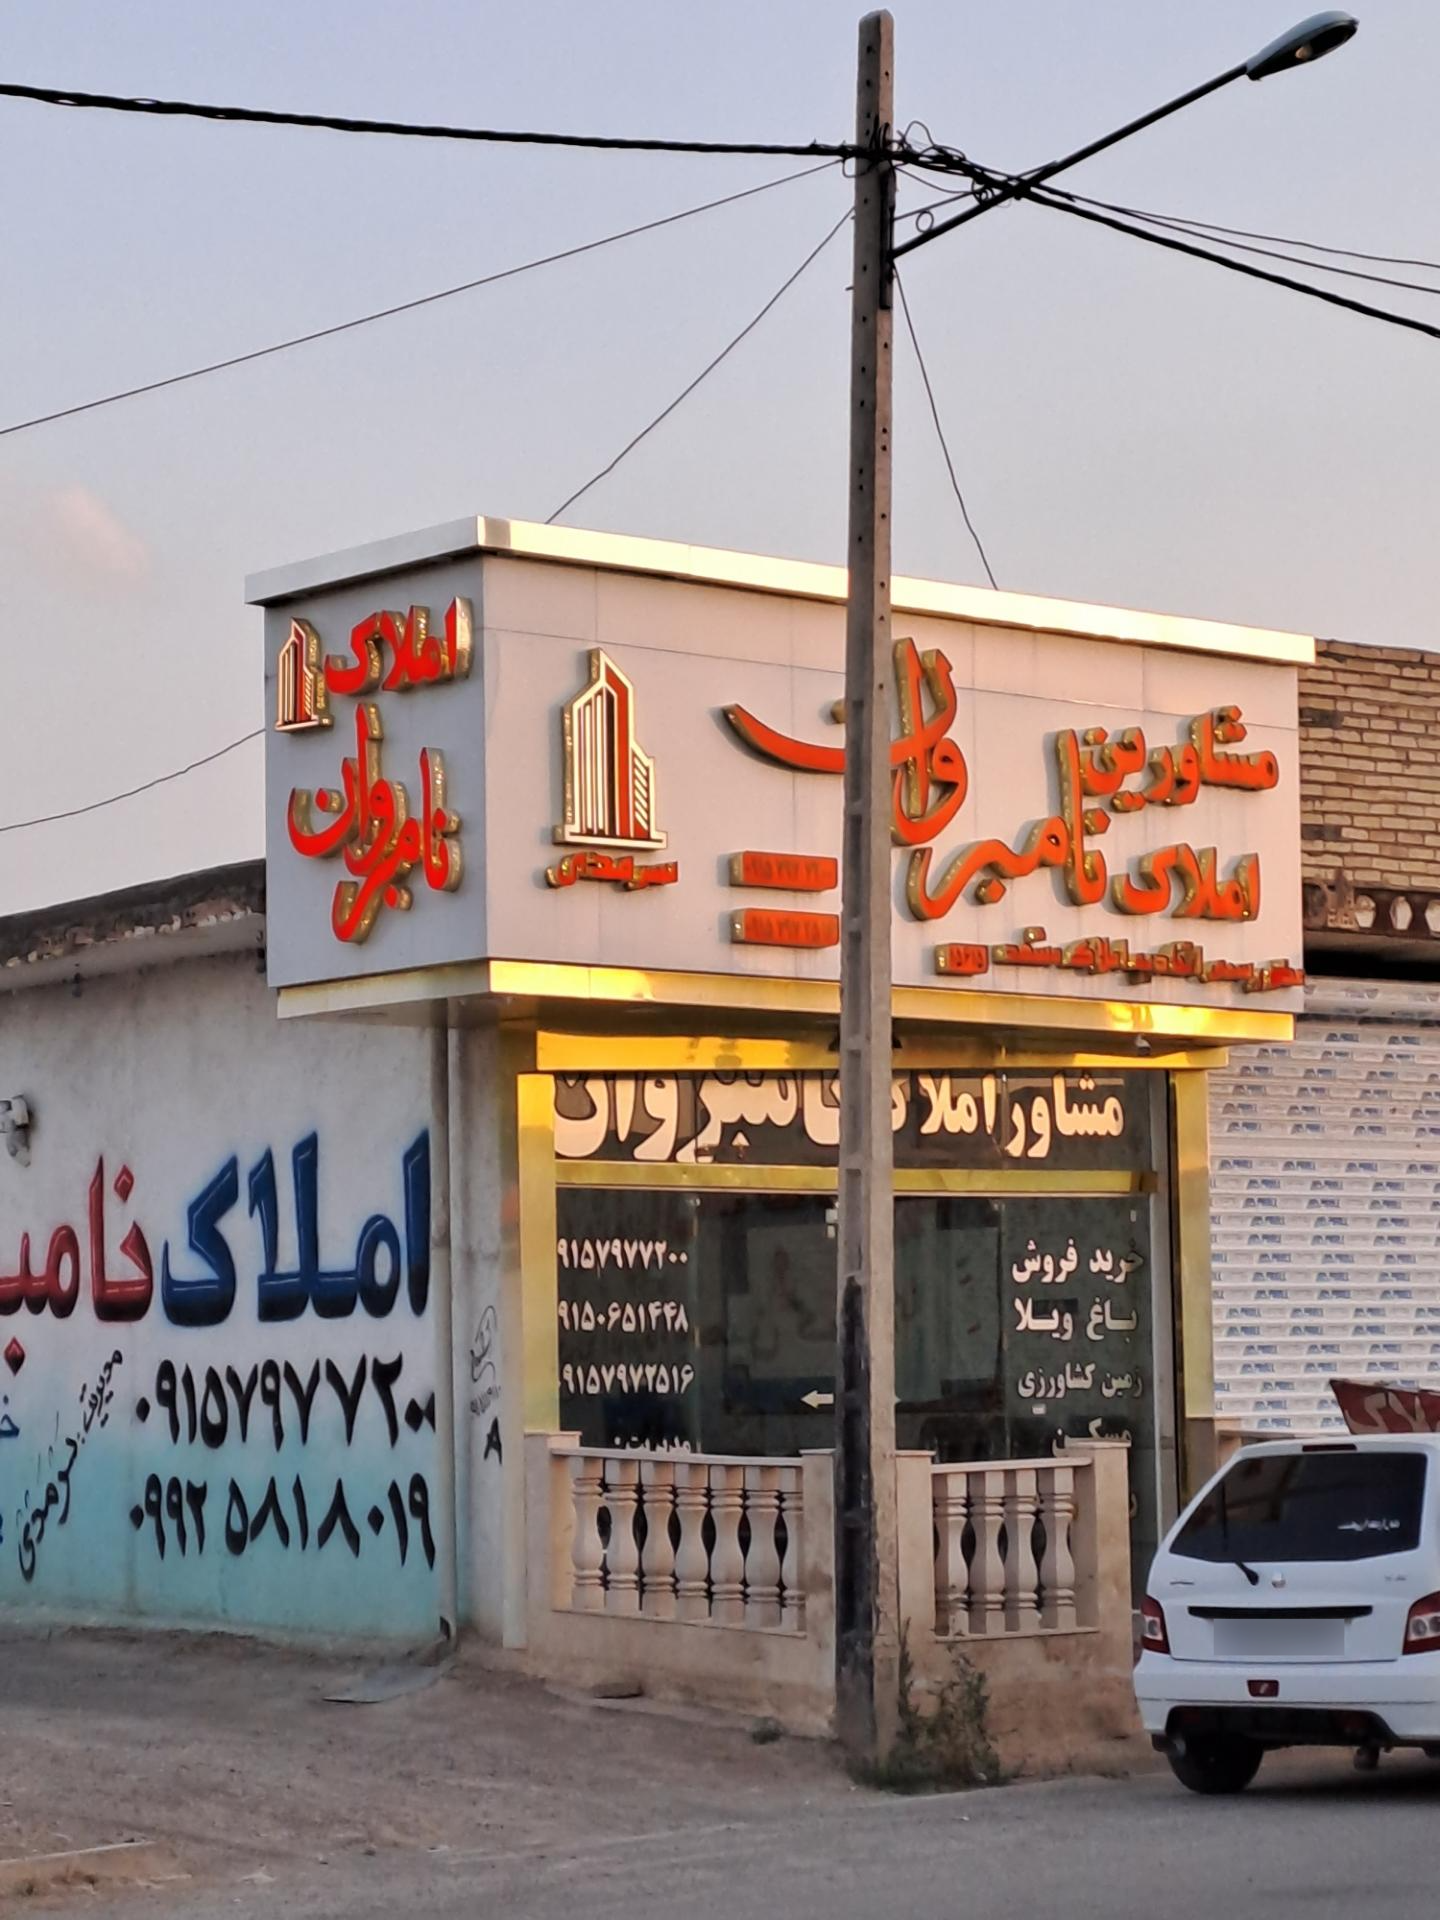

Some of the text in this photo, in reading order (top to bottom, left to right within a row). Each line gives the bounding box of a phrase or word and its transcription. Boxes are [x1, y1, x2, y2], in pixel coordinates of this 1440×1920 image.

[324, 596, 471, 694] املاک
[1080, 705, 1279, 804] مشاورین
[1112, 842, 1260, 921] املاک
[1006, 1072, 1124, 1158] مشاور
[160, 1127, 431, 1327] املاک
[1012, 1238, 1144, 1284] خرید فروش
[1014, 1297, 1139, 1343] باغ ویلا
[558, 1363, 695, 1395] ۹۱۵۷۹۷۲۵۱۶
[1018, 1360, 1097, 1399] کشاورزی
